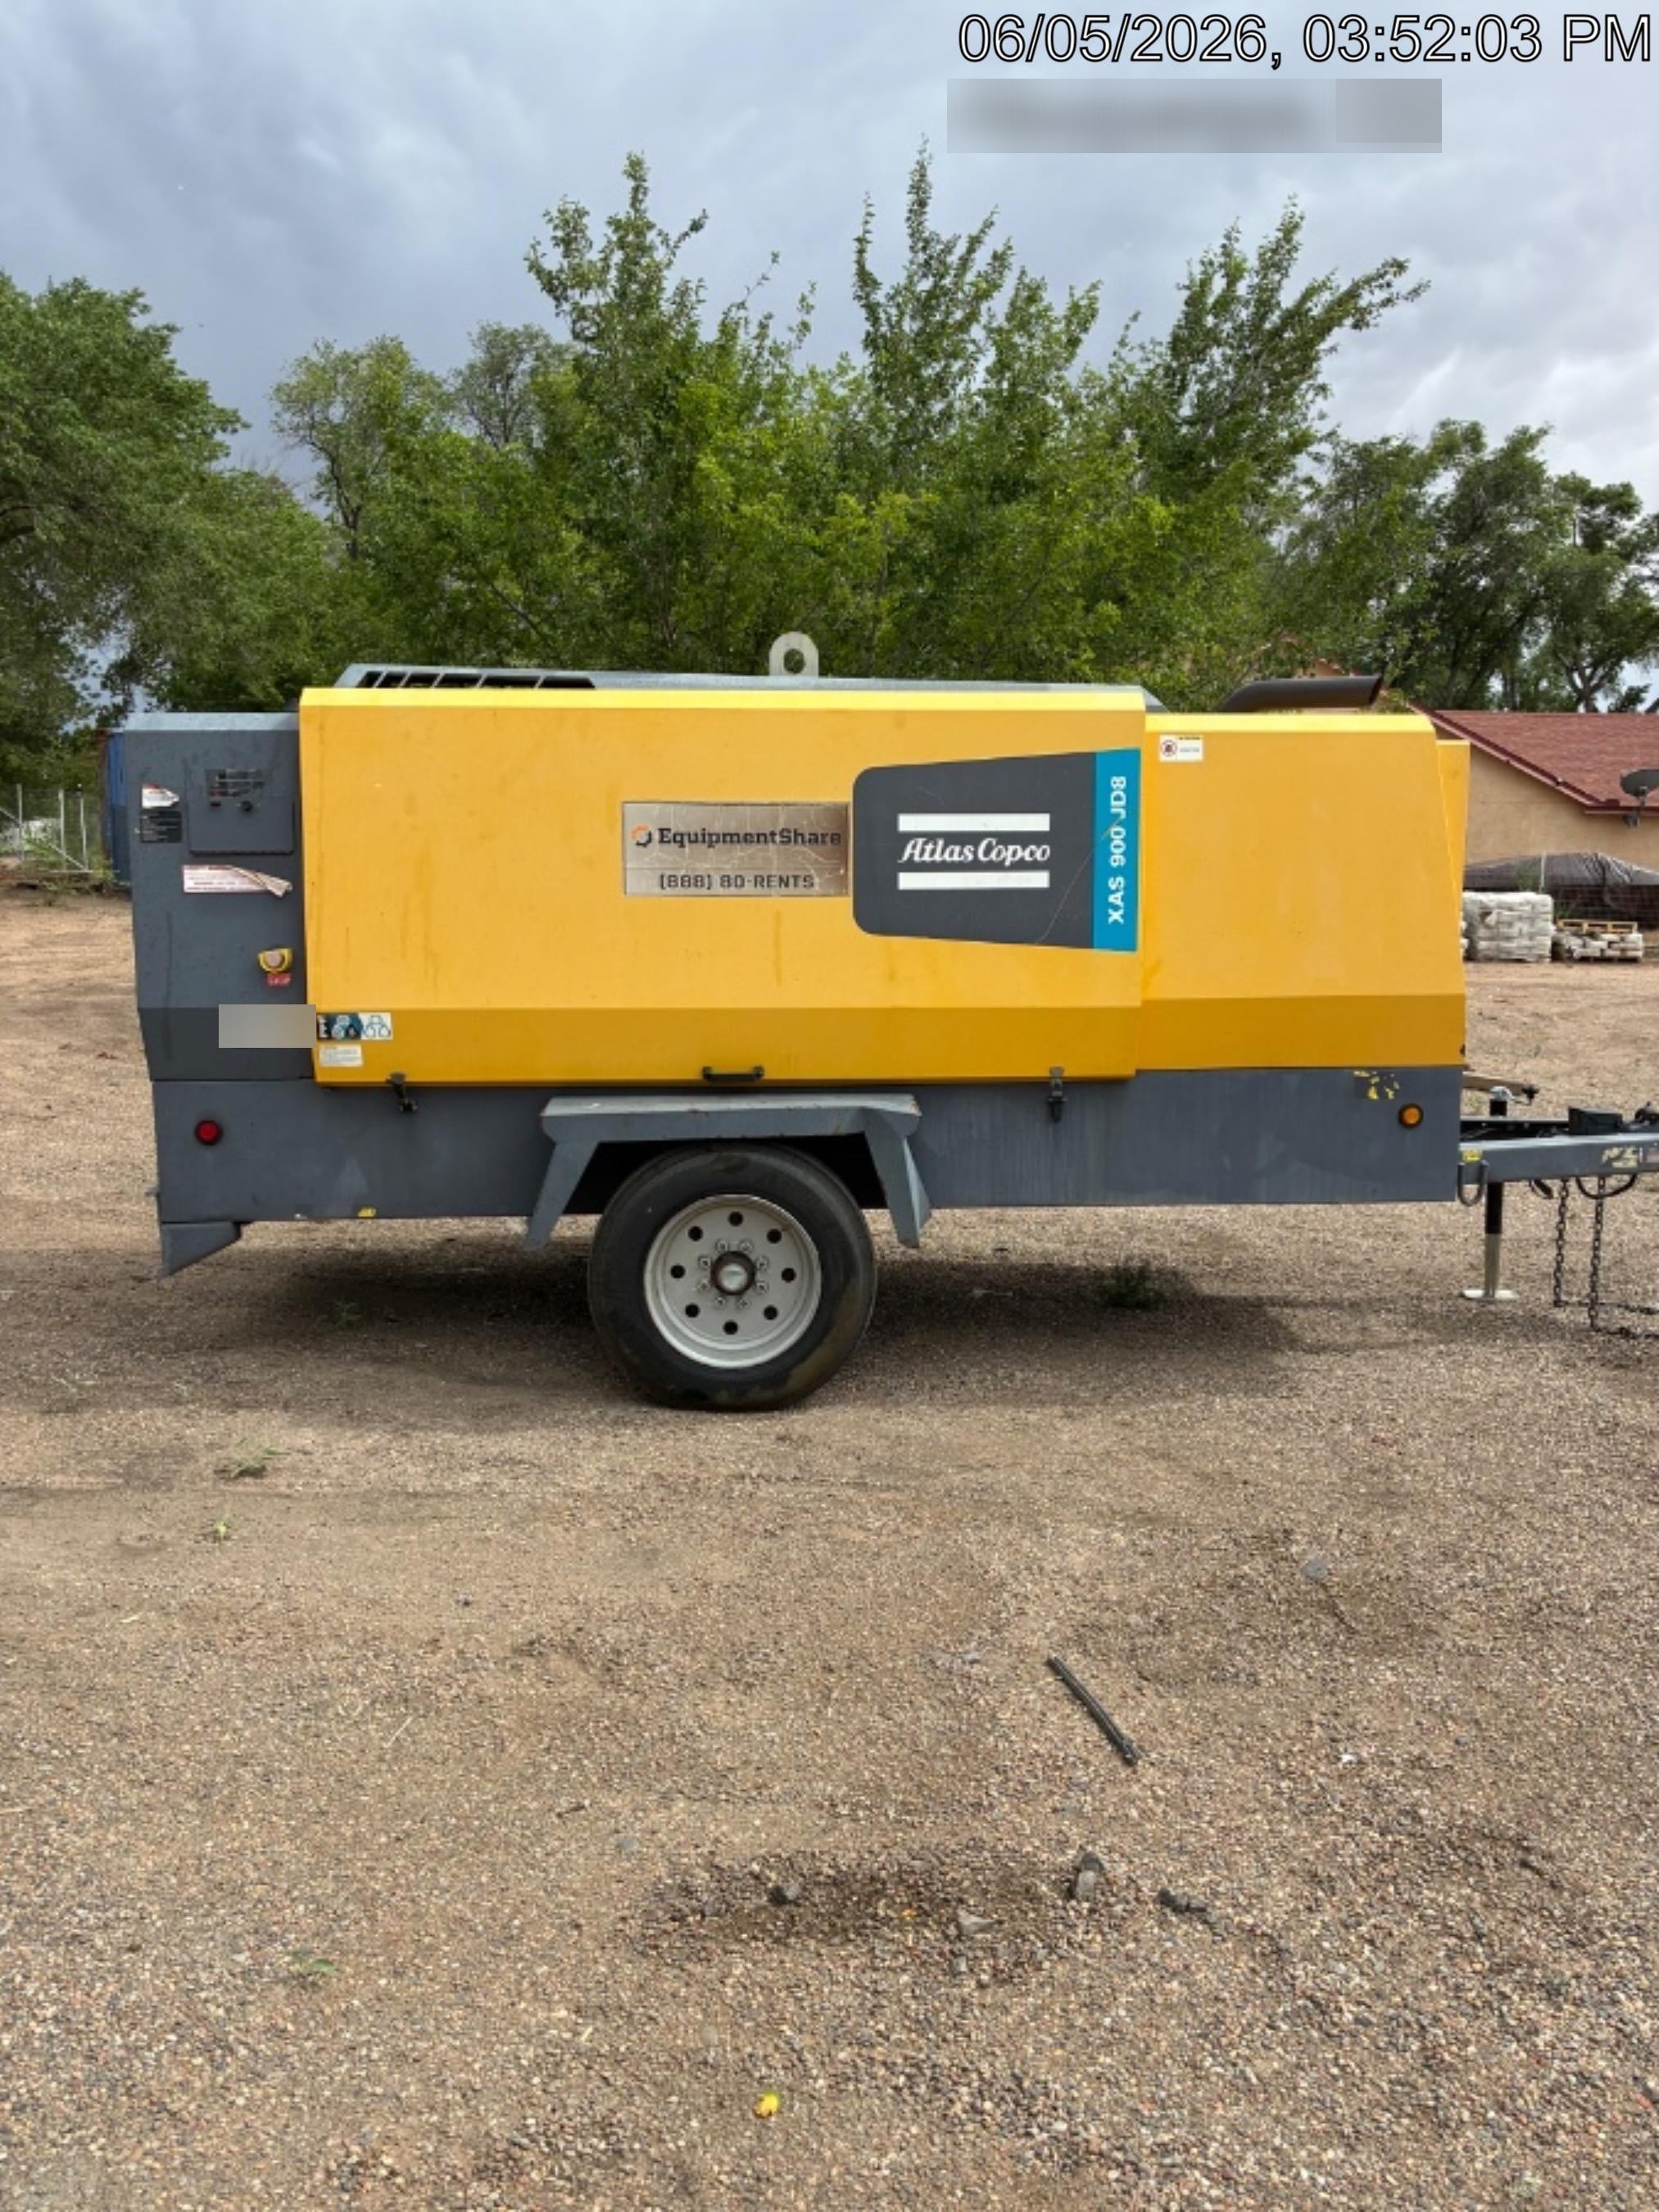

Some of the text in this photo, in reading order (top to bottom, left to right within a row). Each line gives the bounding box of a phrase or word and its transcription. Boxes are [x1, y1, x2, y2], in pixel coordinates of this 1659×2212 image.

[658, 827, 841, 849] EquipmentShare
[897, 836, 1050, 867] Atlas Copco
[1107, 775, 1128, 925] XAS 900 JD8
